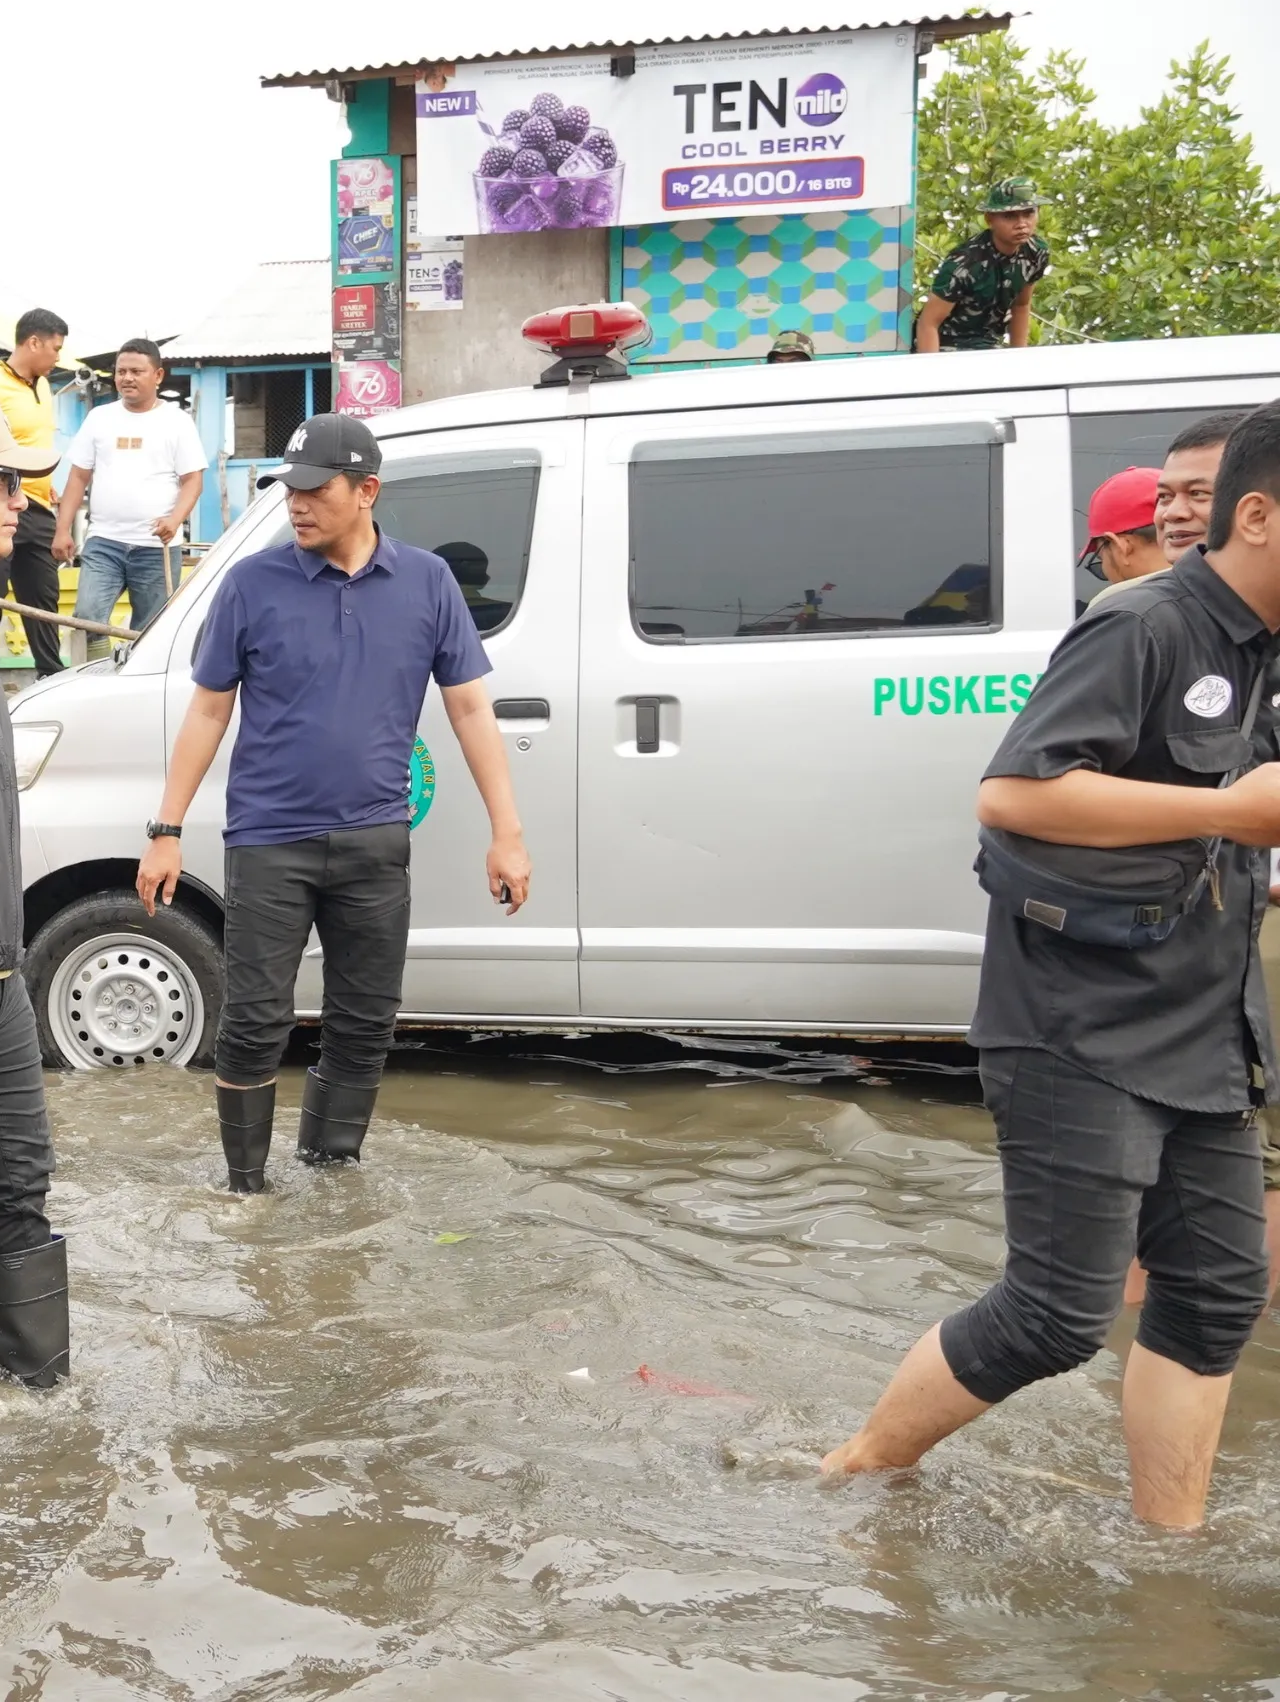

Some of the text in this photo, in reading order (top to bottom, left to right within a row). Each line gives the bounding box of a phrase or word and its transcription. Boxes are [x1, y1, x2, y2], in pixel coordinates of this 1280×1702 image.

[673, 77, 847, 135] TEN mild
[681, 134, 846, 160] COOL BERRY
[806, 179, 823, 192] 16
[824, 176, 853, 190] BTG
[352, 226, 379, 244] CHIEF
[409, 268, 430, 279] TEN
[338, 406, 368, 416] APEL
[873, 672, 1045, 716] PUSKES
[414, 744, 436, 784] ATAN
